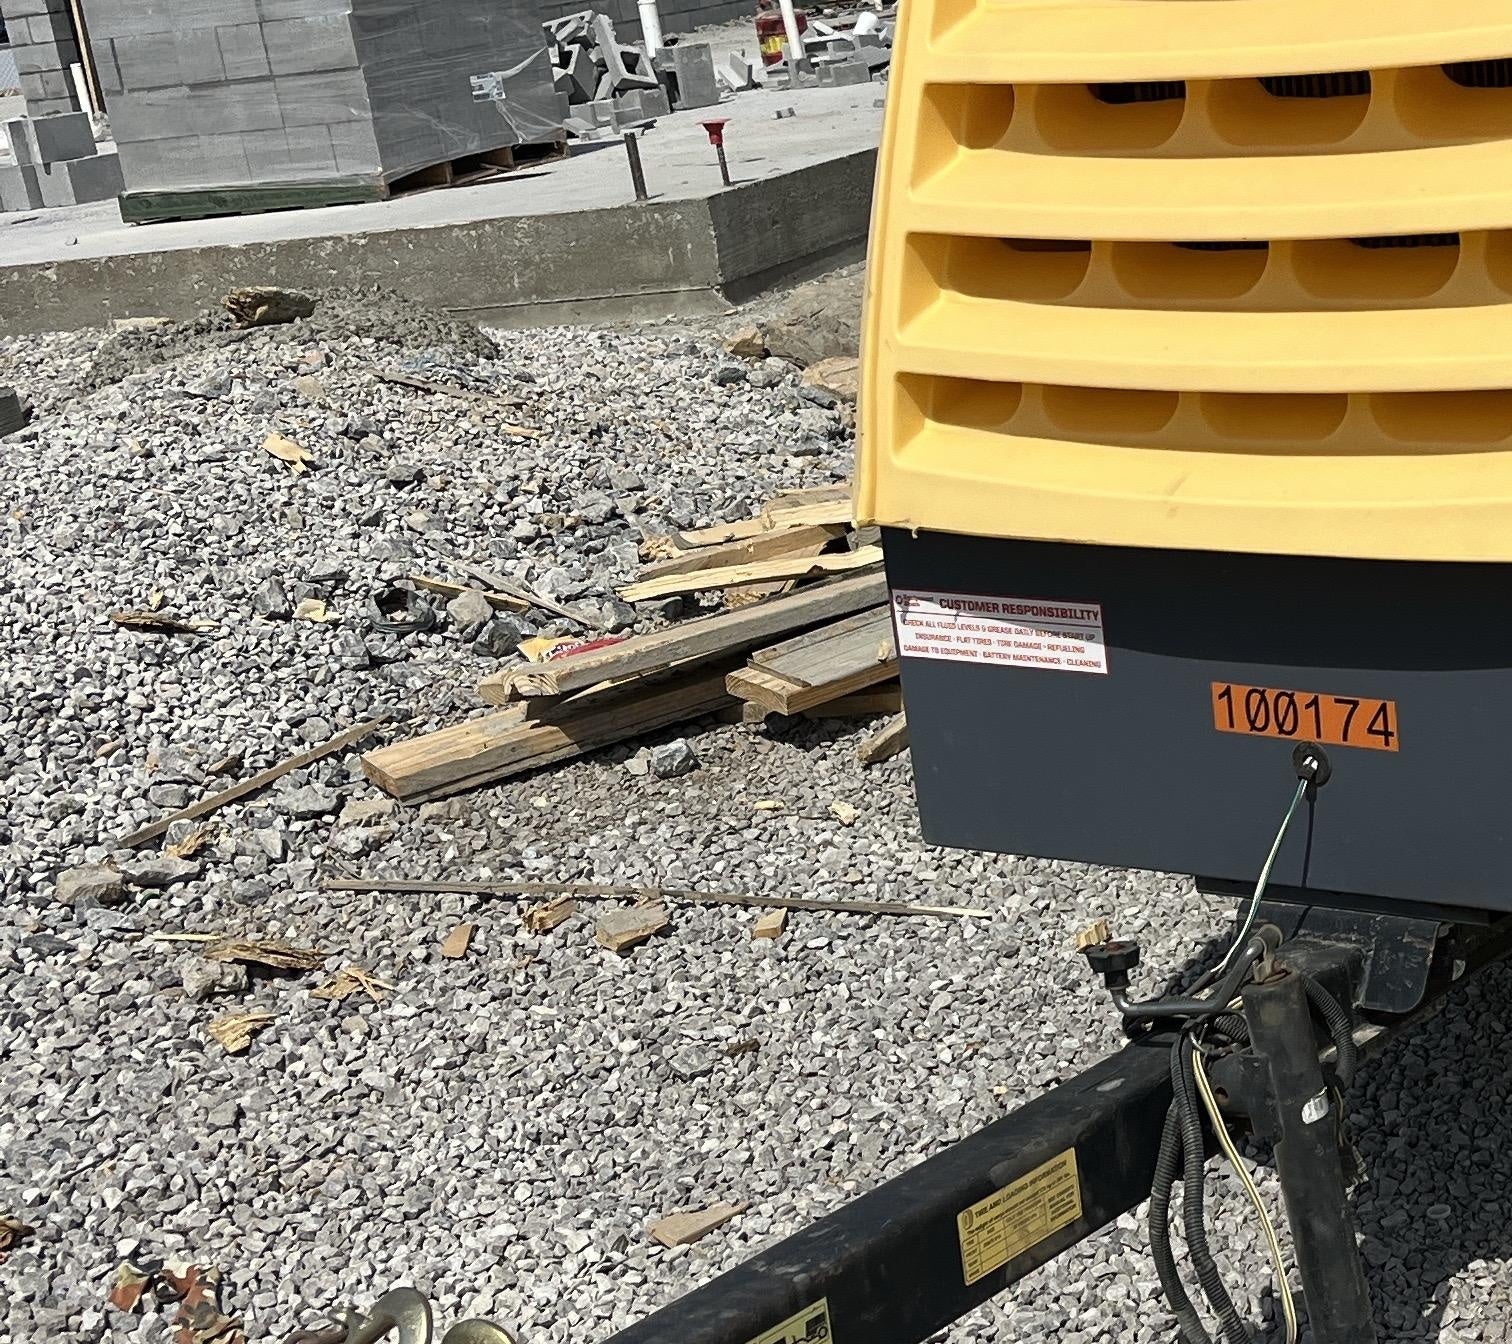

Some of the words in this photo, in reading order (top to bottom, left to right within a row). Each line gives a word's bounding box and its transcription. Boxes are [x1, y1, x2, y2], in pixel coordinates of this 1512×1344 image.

[939, 598, 1000, 613] CUSTOMER
[1001, 603, 1099, 621] RESPONSIBILITY
[1218, 684, 1395, 747] 100174
